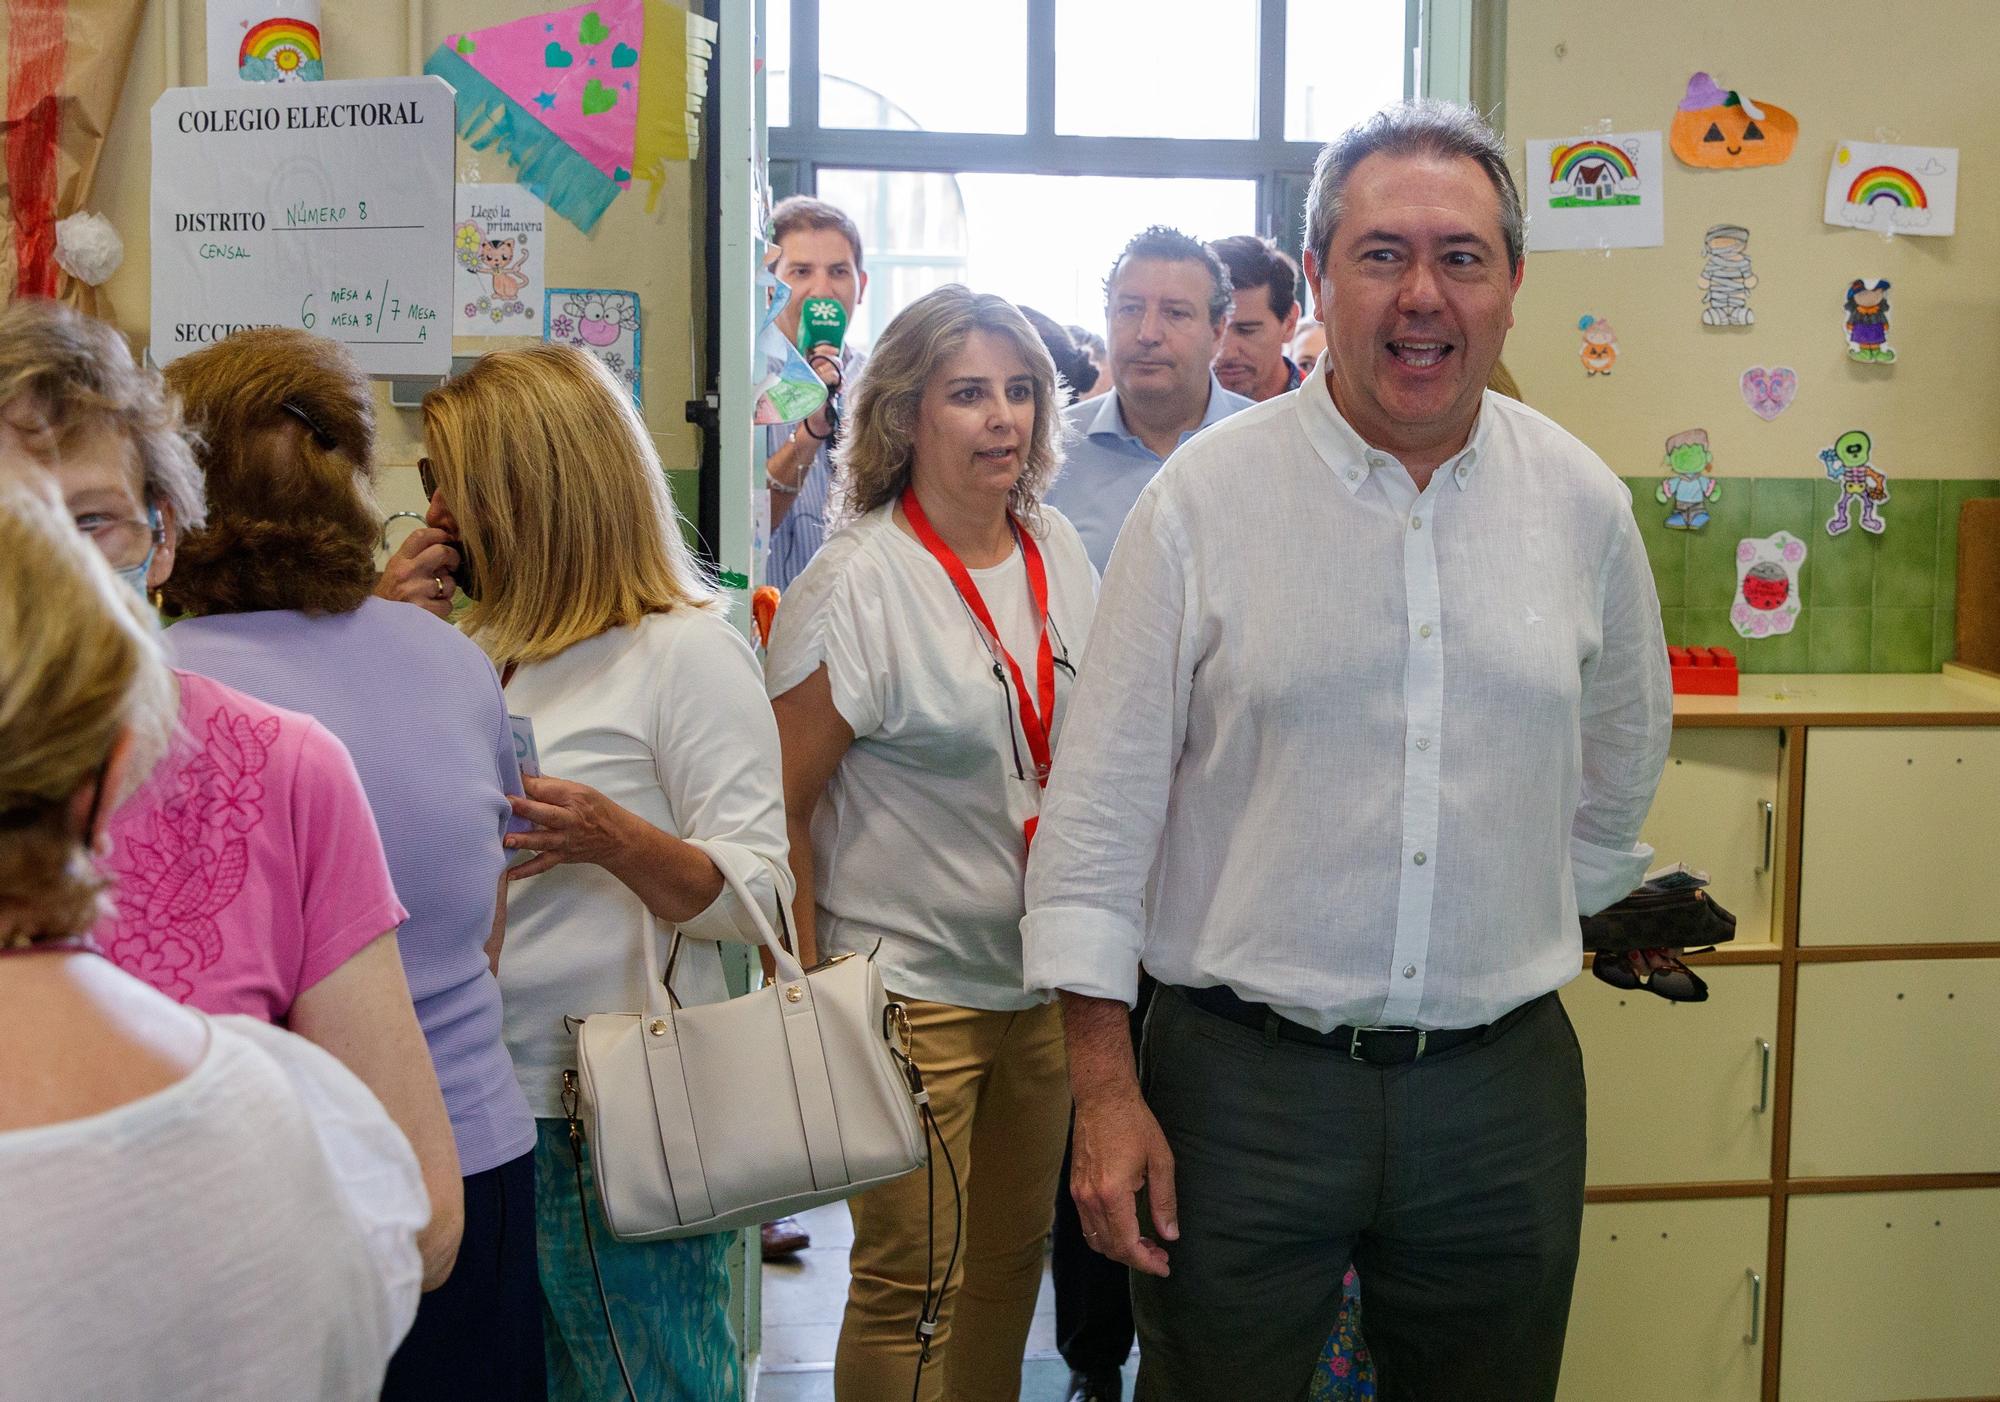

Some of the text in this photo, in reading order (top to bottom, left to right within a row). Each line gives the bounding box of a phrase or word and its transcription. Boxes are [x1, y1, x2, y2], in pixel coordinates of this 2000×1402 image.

[178, 101, 425, 134] COLEGIO ELECTORAL
[175, 201, 368, 233] DISTRITO NÚMERO 8
[470, 205, 511, 219] Llegó la
[486, 219, 543, 235] primavera
[199, 243, 251, 259] CENSAL
[330, 287, 373, 304] MESA A
[301, 293, 316, 329] 6
[391, 299, 401, 321] 7
[407, 303, 437, 321] MESA
[331, 313, 373, 328] MESA B
[418, 325, 427, 340] A
